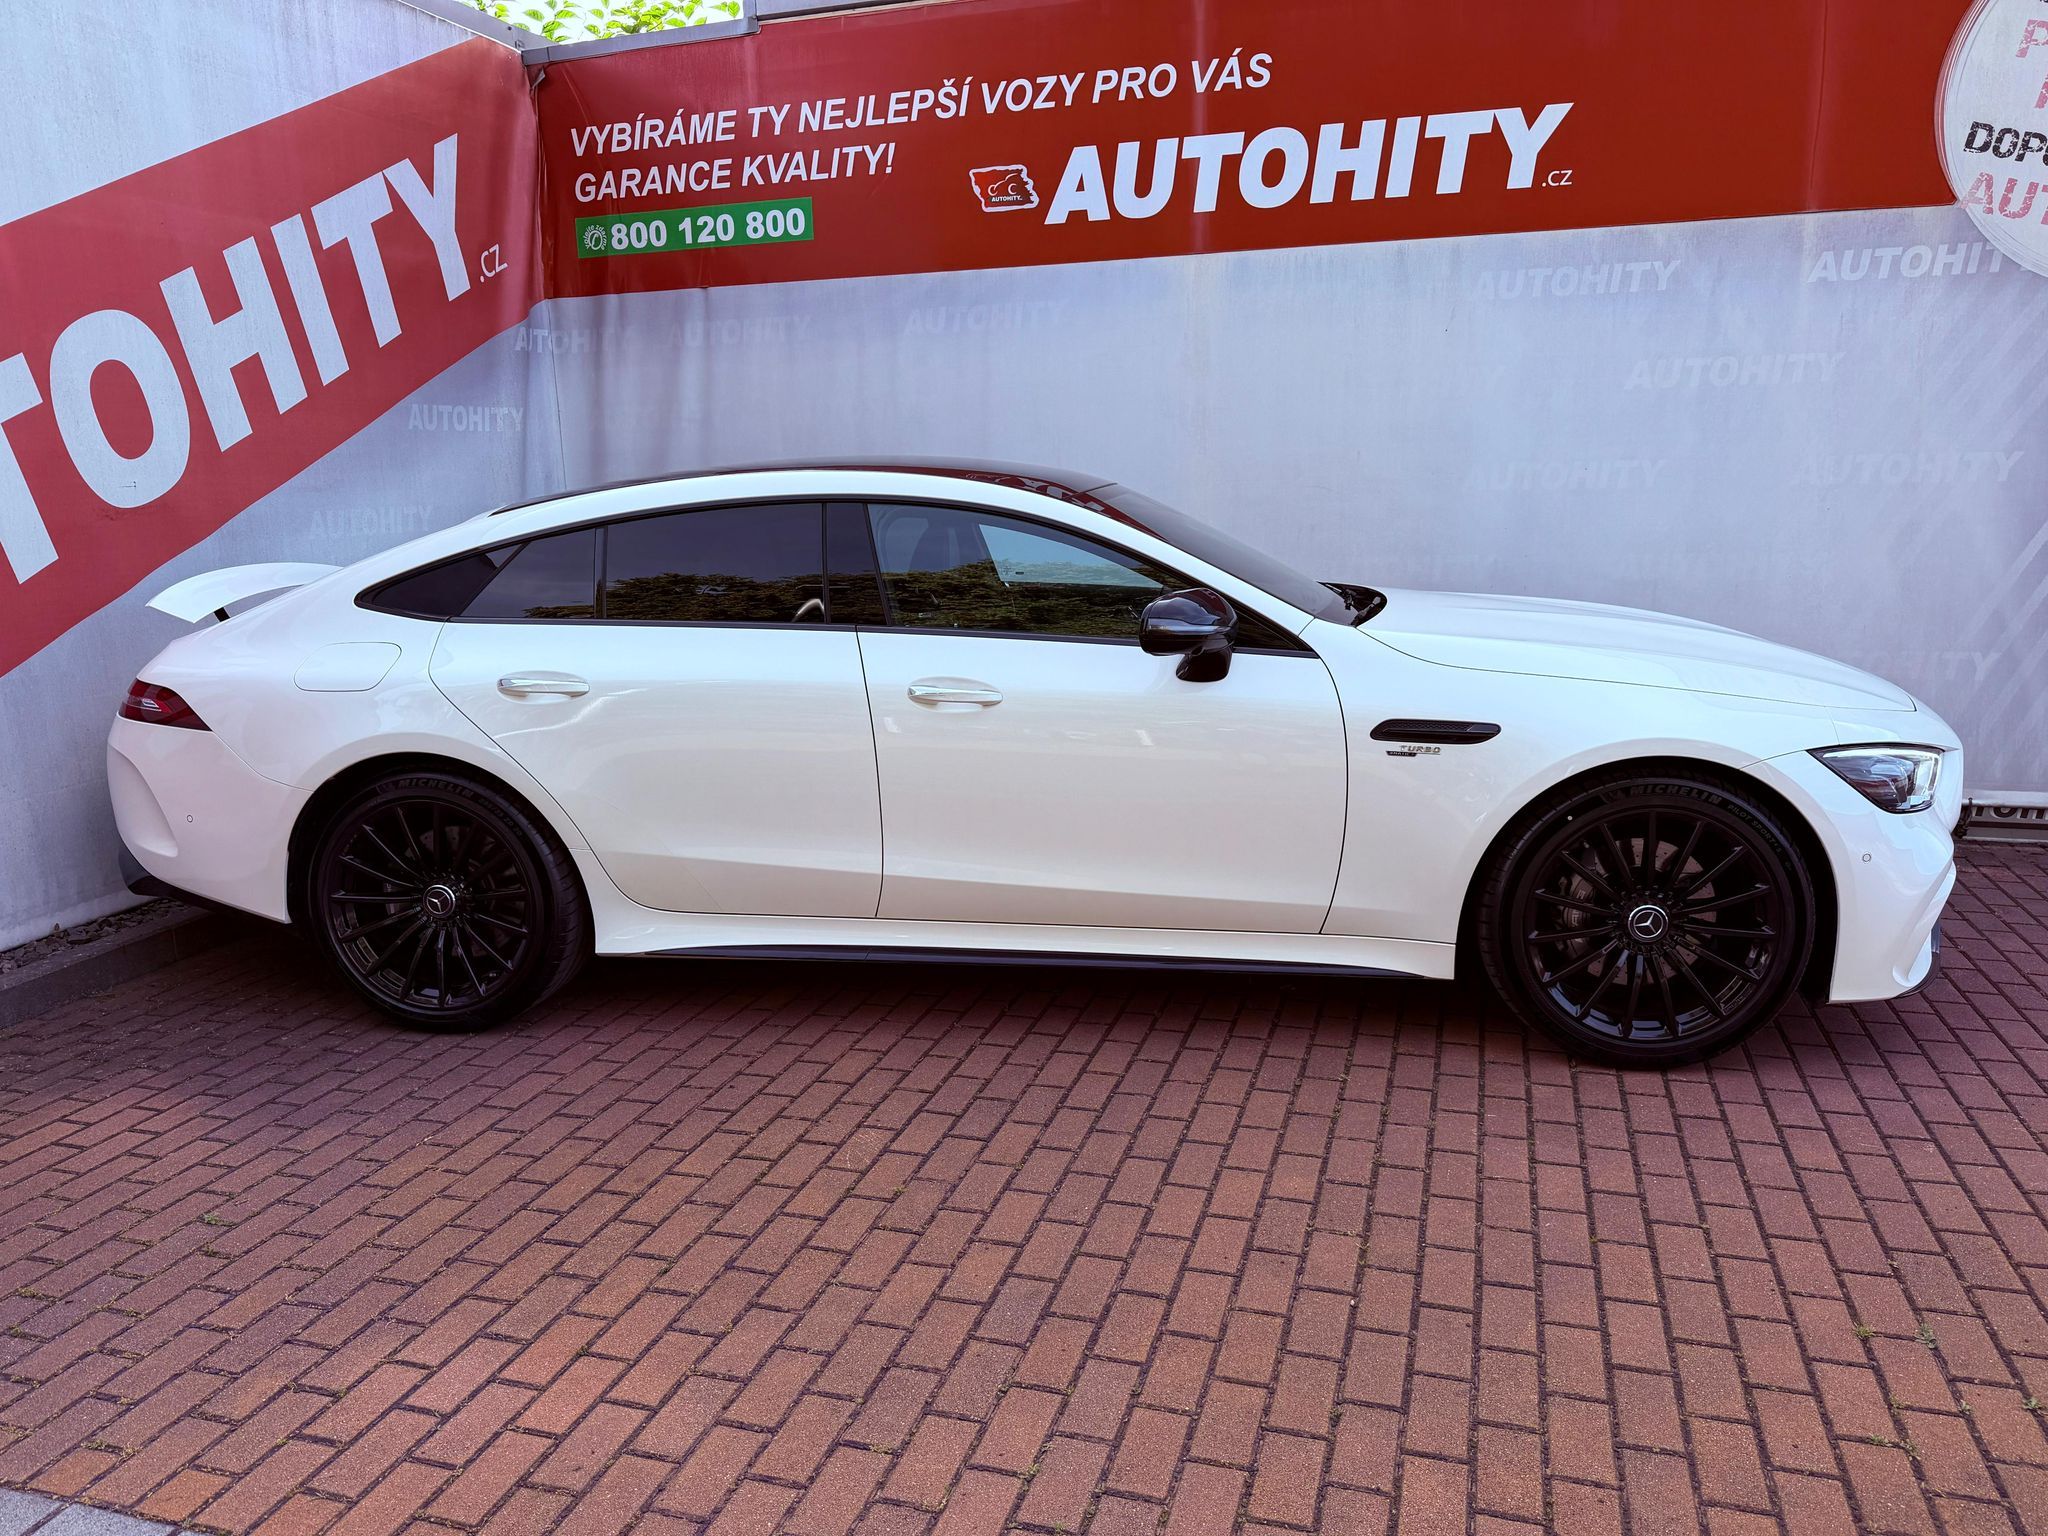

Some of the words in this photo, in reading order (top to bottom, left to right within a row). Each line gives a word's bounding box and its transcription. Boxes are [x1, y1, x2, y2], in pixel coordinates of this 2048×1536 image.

[571, 109, 737, 156] VYBÍRÁME
[747, 104, 791, 138] TY
[798, 76, 974, 132] NEJLEPŠÍ
[981, 73, 1085, 114] VOZY
[1092, 62, 1177, 103] PRO
[1191, 48, 1273, 93] VÁS
[1962, 121, 2048, 166] DOP
[574, 158, 732, 203] GARANCE
[741, 142, 896, 187] KVALITY!
[611, 220, 668, 250] 800
[678, 214, 735, 245] 120
[746, 208, 806, 240] 800
[1470, 260, 1681, 301] AUTOHITY
[1623, 352, 1846, 391] AUTOHITY
[408, 403, 524, 432] AUTOHITY
[1399, 745, 1441, 753] TURBO
[397, 779, 475, 798] MICHELIN
[1629, 784, 1723, 805] MICHELIN
[1727, 803, 1753, 823] PILOT
